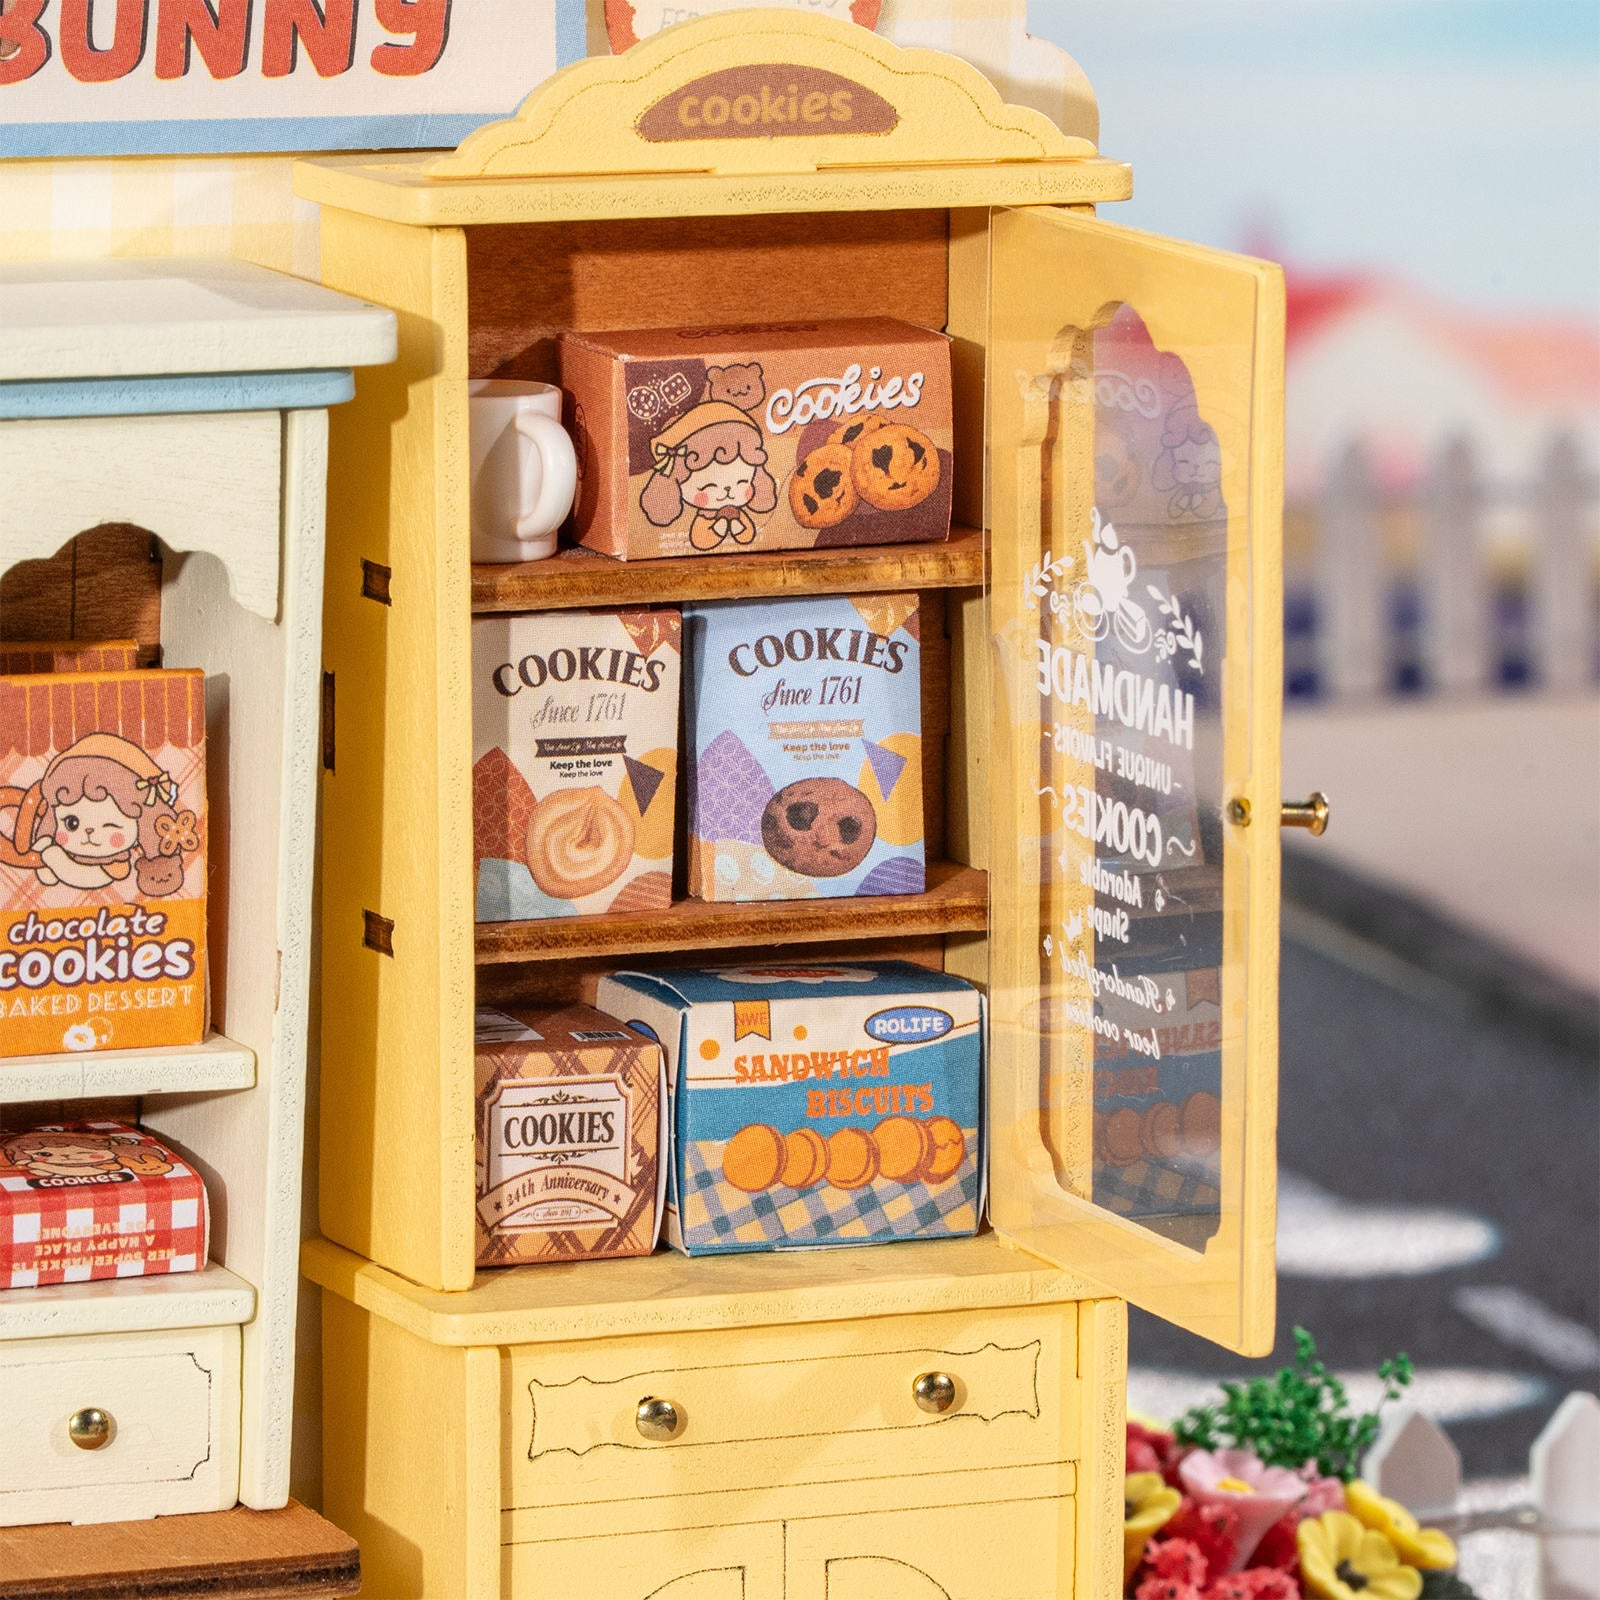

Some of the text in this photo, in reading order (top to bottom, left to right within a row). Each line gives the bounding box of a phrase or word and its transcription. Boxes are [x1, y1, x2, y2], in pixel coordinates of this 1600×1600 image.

[677, 84, 853, 127] cookies
[765, 363, 925, 436] Cookies
[728, 627, 909, 677] COOKIES
[492, 646, 666, 697] COOKIES
[530, 692, 626, 730] Since 1761
[761, 675, 863, 717] Since 1761
[550, 758, 613, 771] Keep the love
[8, 903, 166, 945] chocolate
[0, 938, 195, 989] cookies
[88, 984, 194, 1012] DESSERT
[874, 1016, 946, 1036] ROLIFE
[734, 1048, 891, 1084] SANDWICH
[806, 1082, 935, 1118] BISCUITS
[504, 1110, 616, 1149] COOKIES
[38, 1172, 123, 1188] cookies
[540, 1172, 611, 1201] Anniversary
[34, 1244, 81, 1257] PLACE
[86, 1237, 141, 1253] HAPPY
